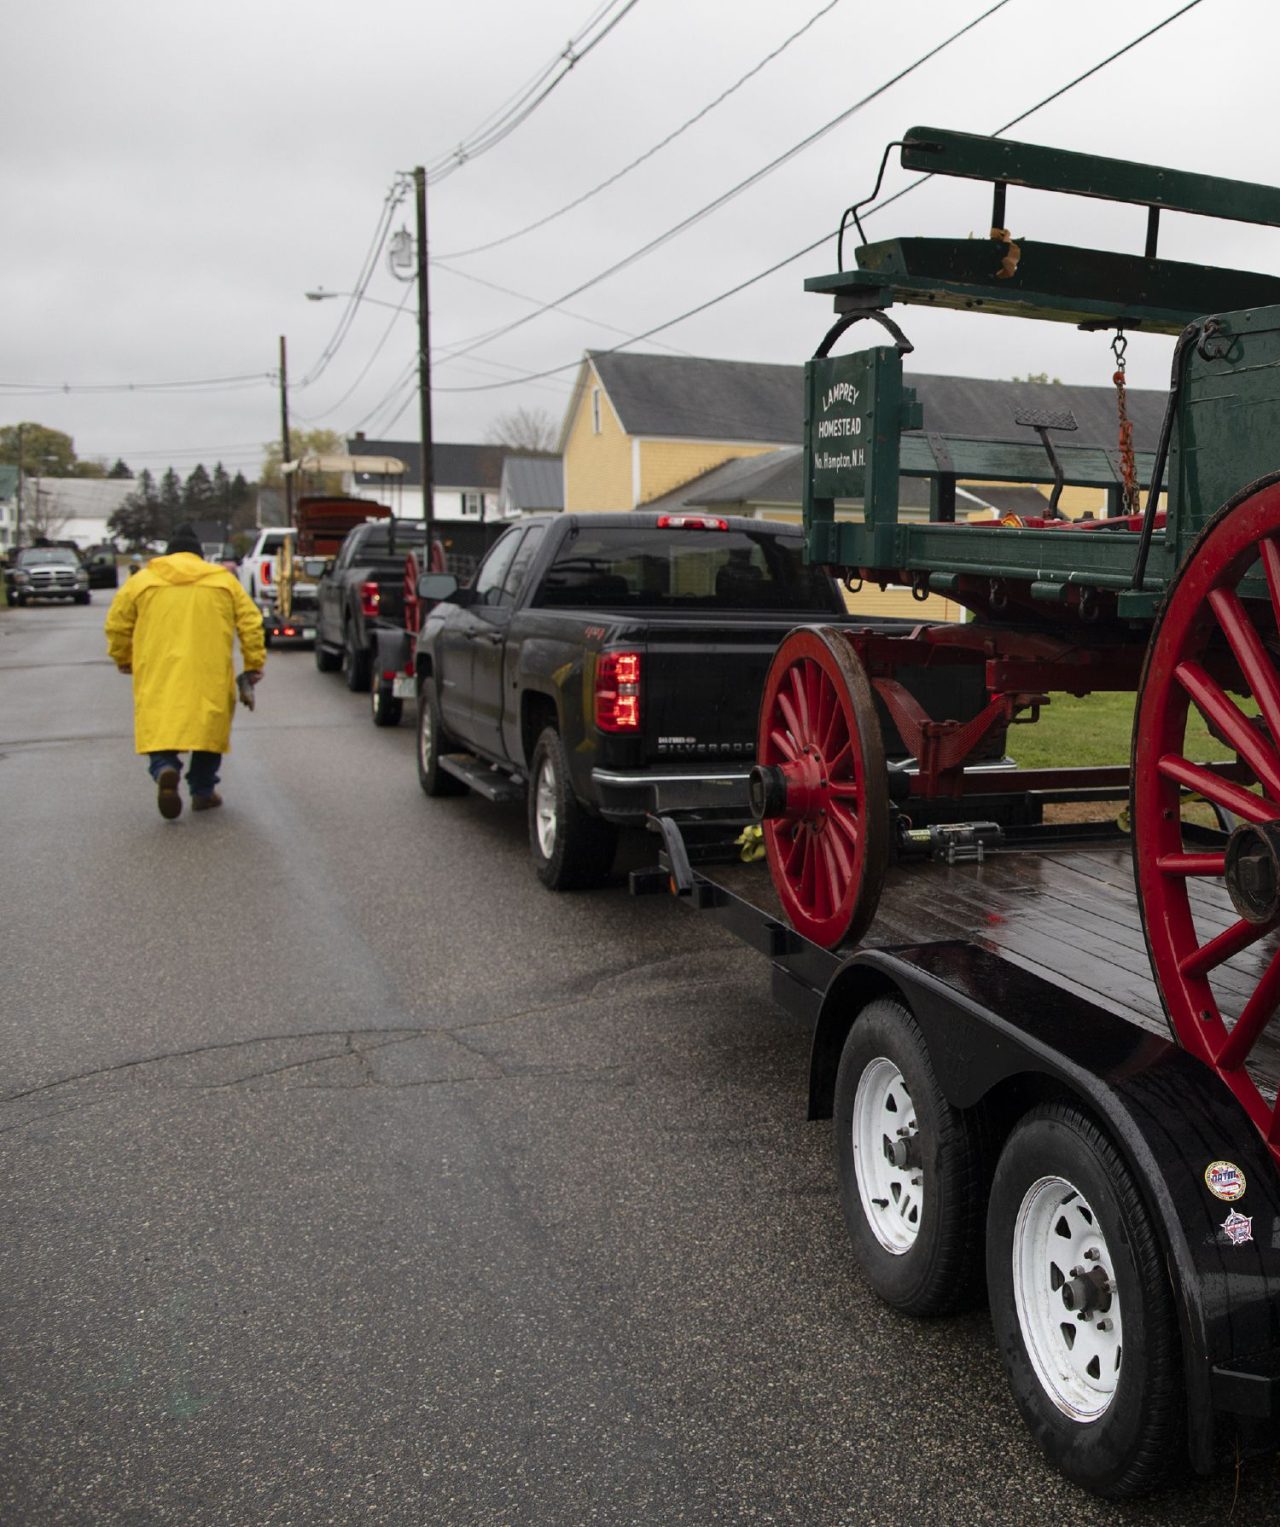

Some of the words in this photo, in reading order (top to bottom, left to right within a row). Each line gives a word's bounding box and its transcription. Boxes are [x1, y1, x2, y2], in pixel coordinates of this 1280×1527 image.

[822, 383, 860, 412] LAMPREY
[818, 417, 862, 438] HOMESTEAD
[658, 742, 754, 753] SILVERADO
